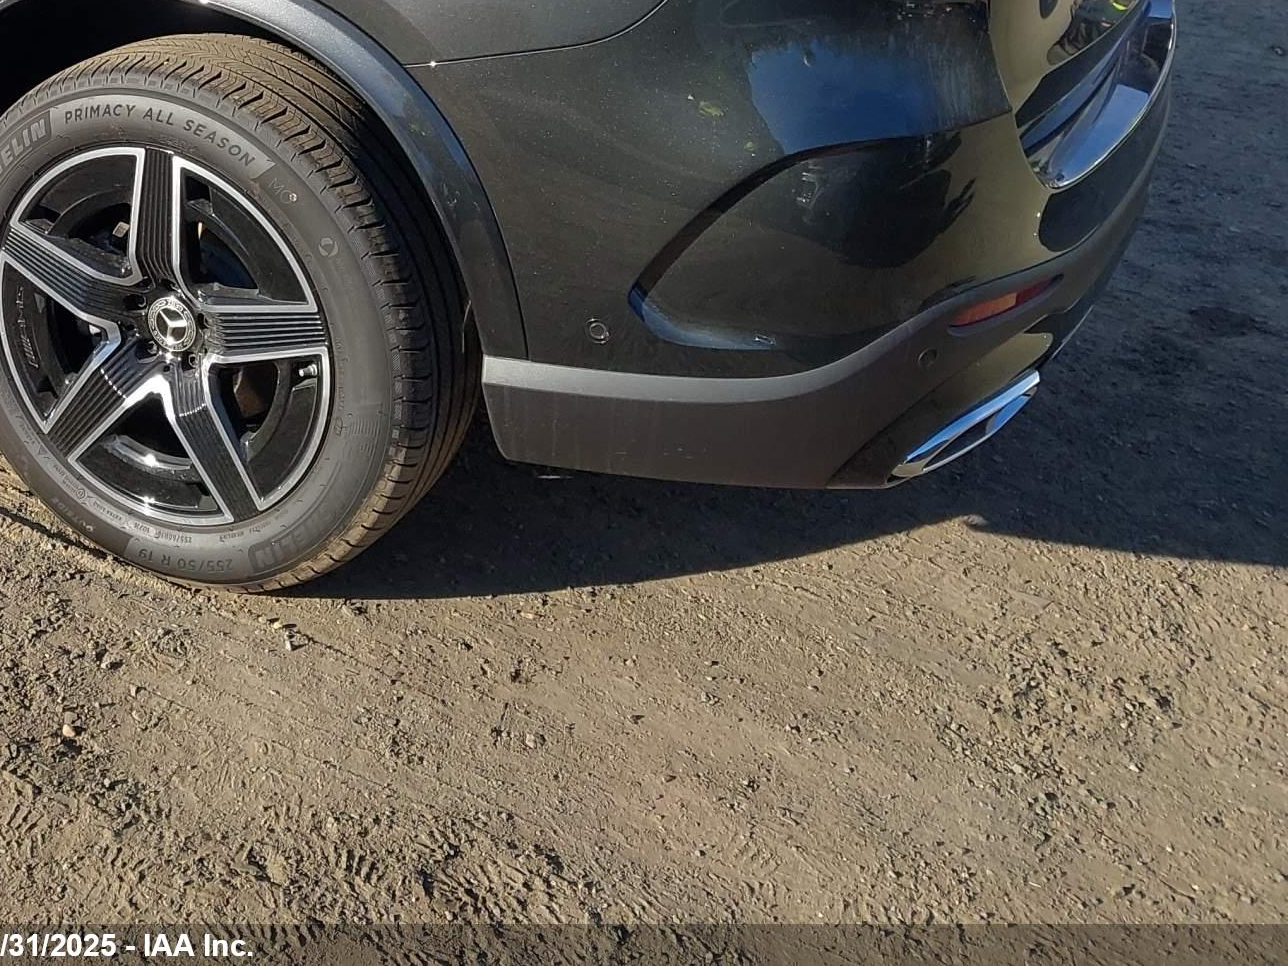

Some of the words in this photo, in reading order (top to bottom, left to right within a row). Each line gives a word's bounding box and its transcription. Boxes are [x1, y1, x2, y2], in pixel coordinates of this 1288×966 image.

[64, 103, 138, 125] PRIMACY
[142, 106, 175, 127] ALL
[183, 118, 257, 168] SEASON
[138, 548, 154, 561] 19
[161, 554, 170, 566] R
[177, 557, 234, 573] 255/50
